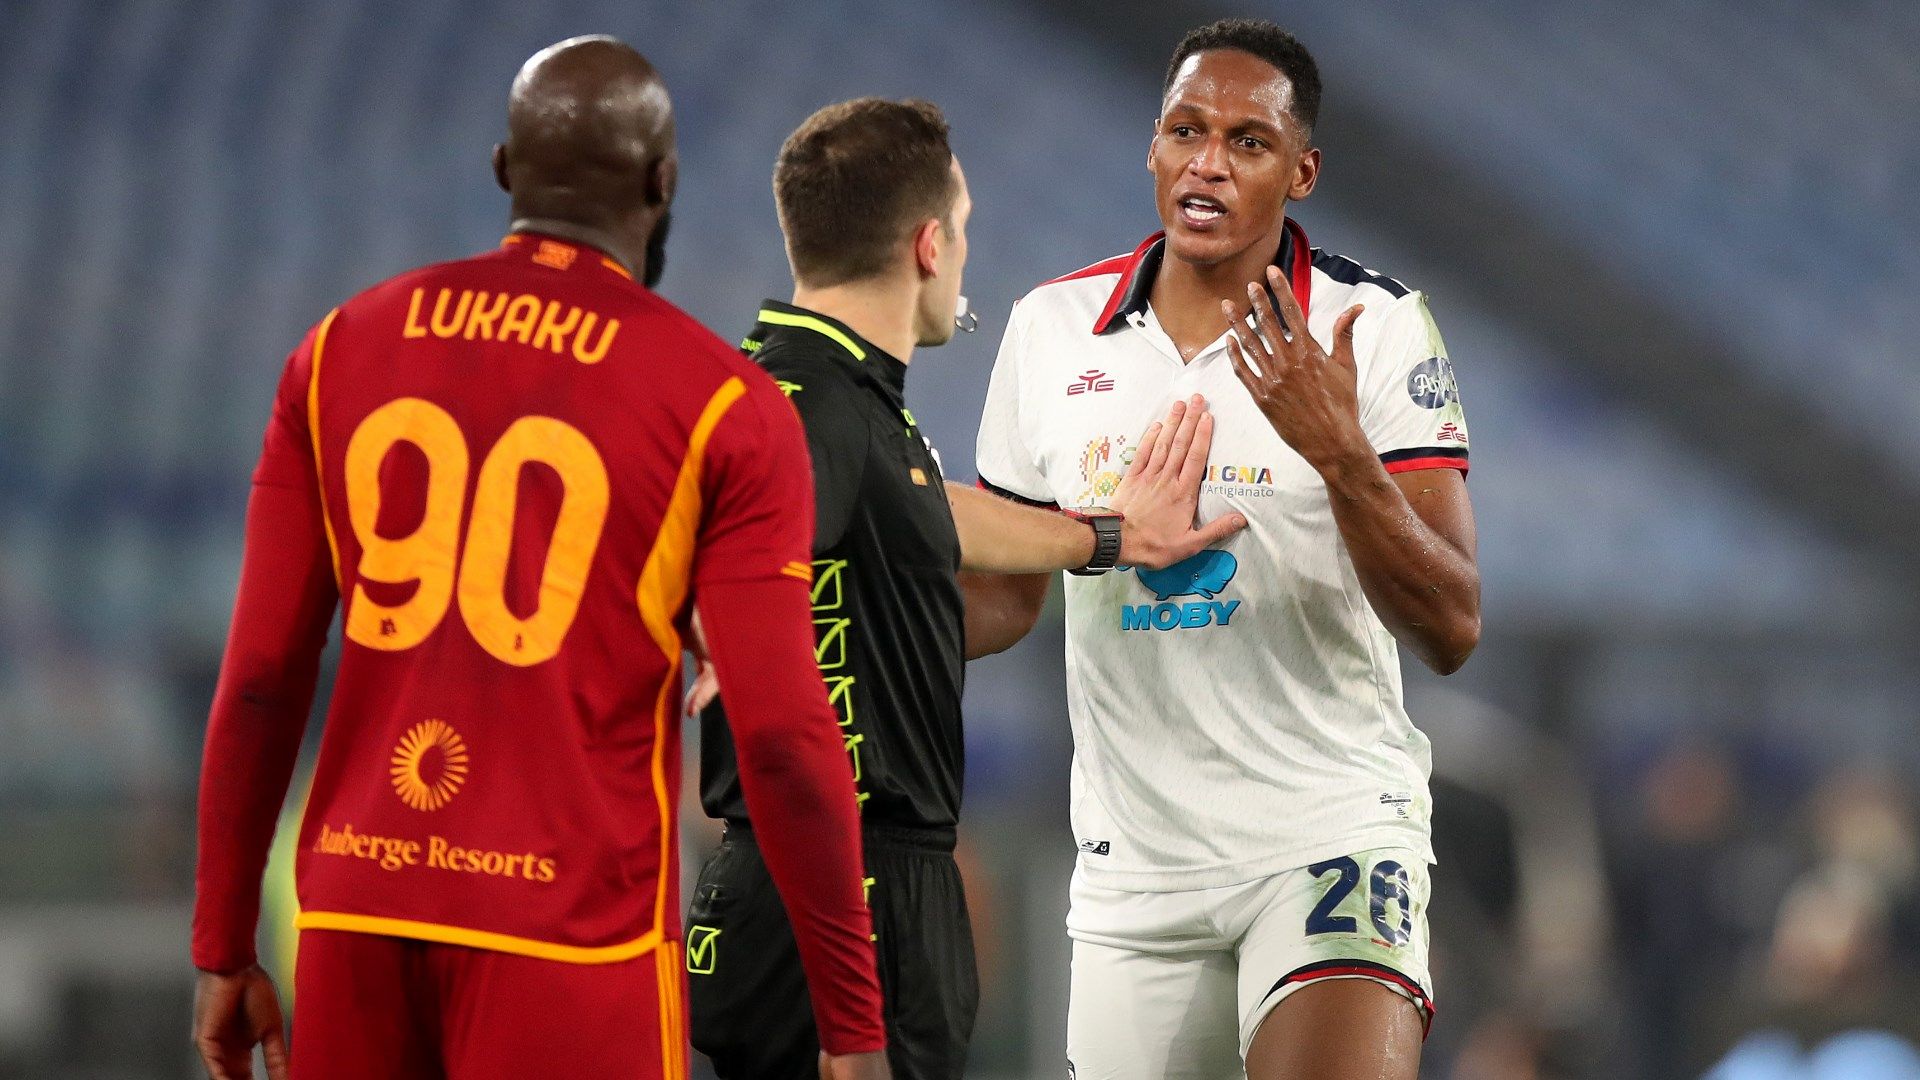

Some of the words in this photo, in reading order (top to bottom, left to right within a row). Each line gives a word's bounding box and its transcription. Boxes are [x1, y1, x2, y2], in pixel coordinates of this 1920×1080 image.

[402, 287, 620, 365] LUKAKU
[1201, 484, 1275, 499] l'Artigianato
[344, 396, 611, 668] 90
[1121, 599, 1241, 632] MOBY
[427, 835, 556, 883] Resorts
[1305, 855, 1412, 948] 26
